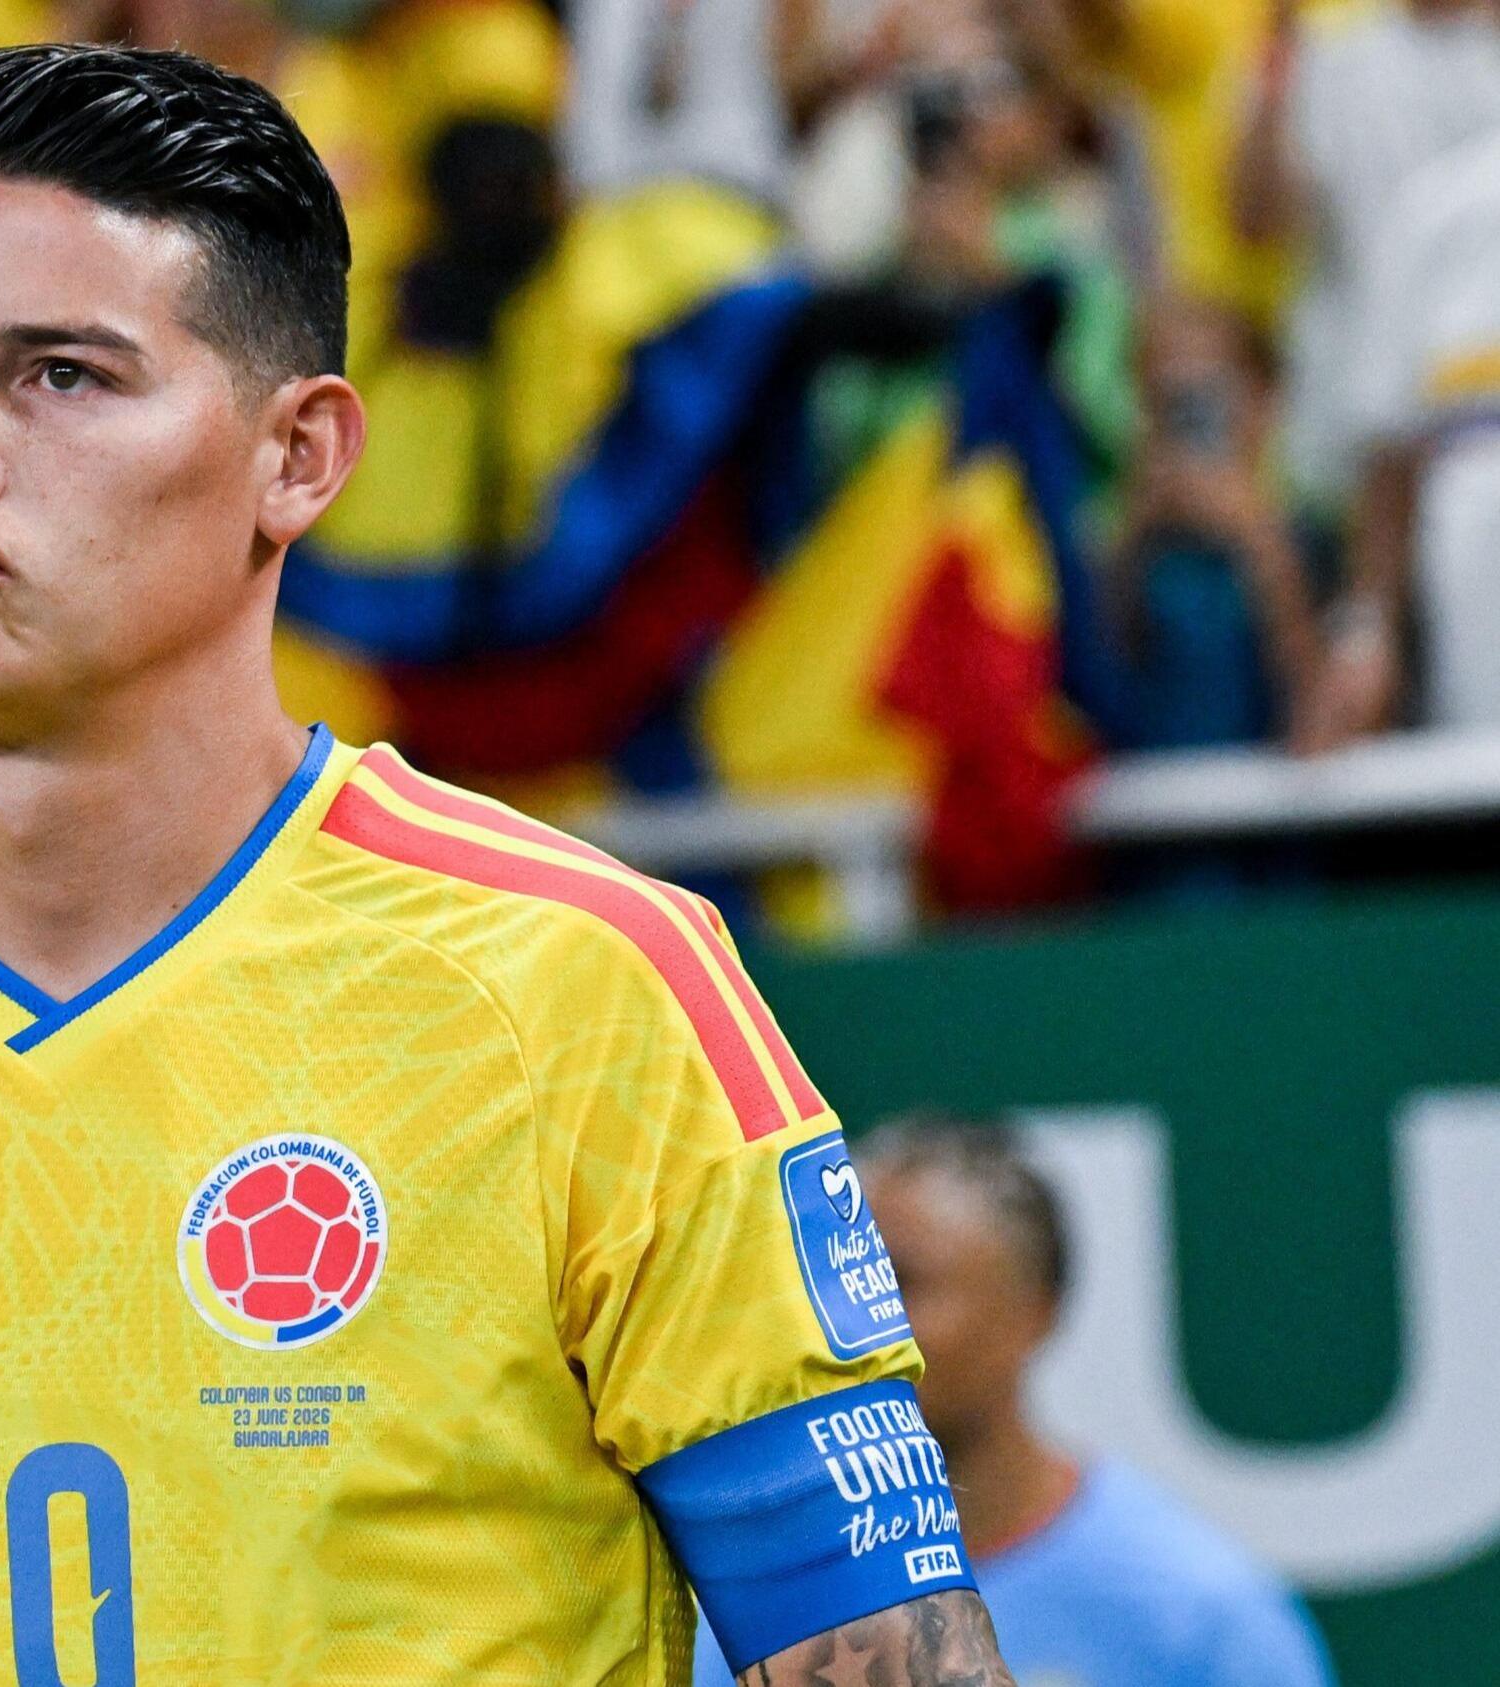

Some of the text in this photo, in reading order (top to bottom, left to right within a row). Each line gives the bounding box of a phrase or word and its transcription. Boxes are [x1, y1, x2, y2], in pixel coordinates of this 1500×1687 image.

[250, 1141, 344, 1169] COLOMBIANA
[342, 1162, 361, 1182] DE
[827, 1228, 870, 1272] Unite
[868, 1297, 905, 1323] FIFA
[199, 1387, 270, 1405] COLOMBIA
[296, 1385, 342, 1403] CONGO
[347, 1385, 366, 1403] DR
[233, 1408, 331, 1426] 23 JUNE 2026
[234, 1430, 330, 1448] GUADALAJARA
[825, 1436, 950, 1504] UNITE
[838, 1493, 961, 1558] the Wor
[911, 1549, 959, 1576] FIFA
